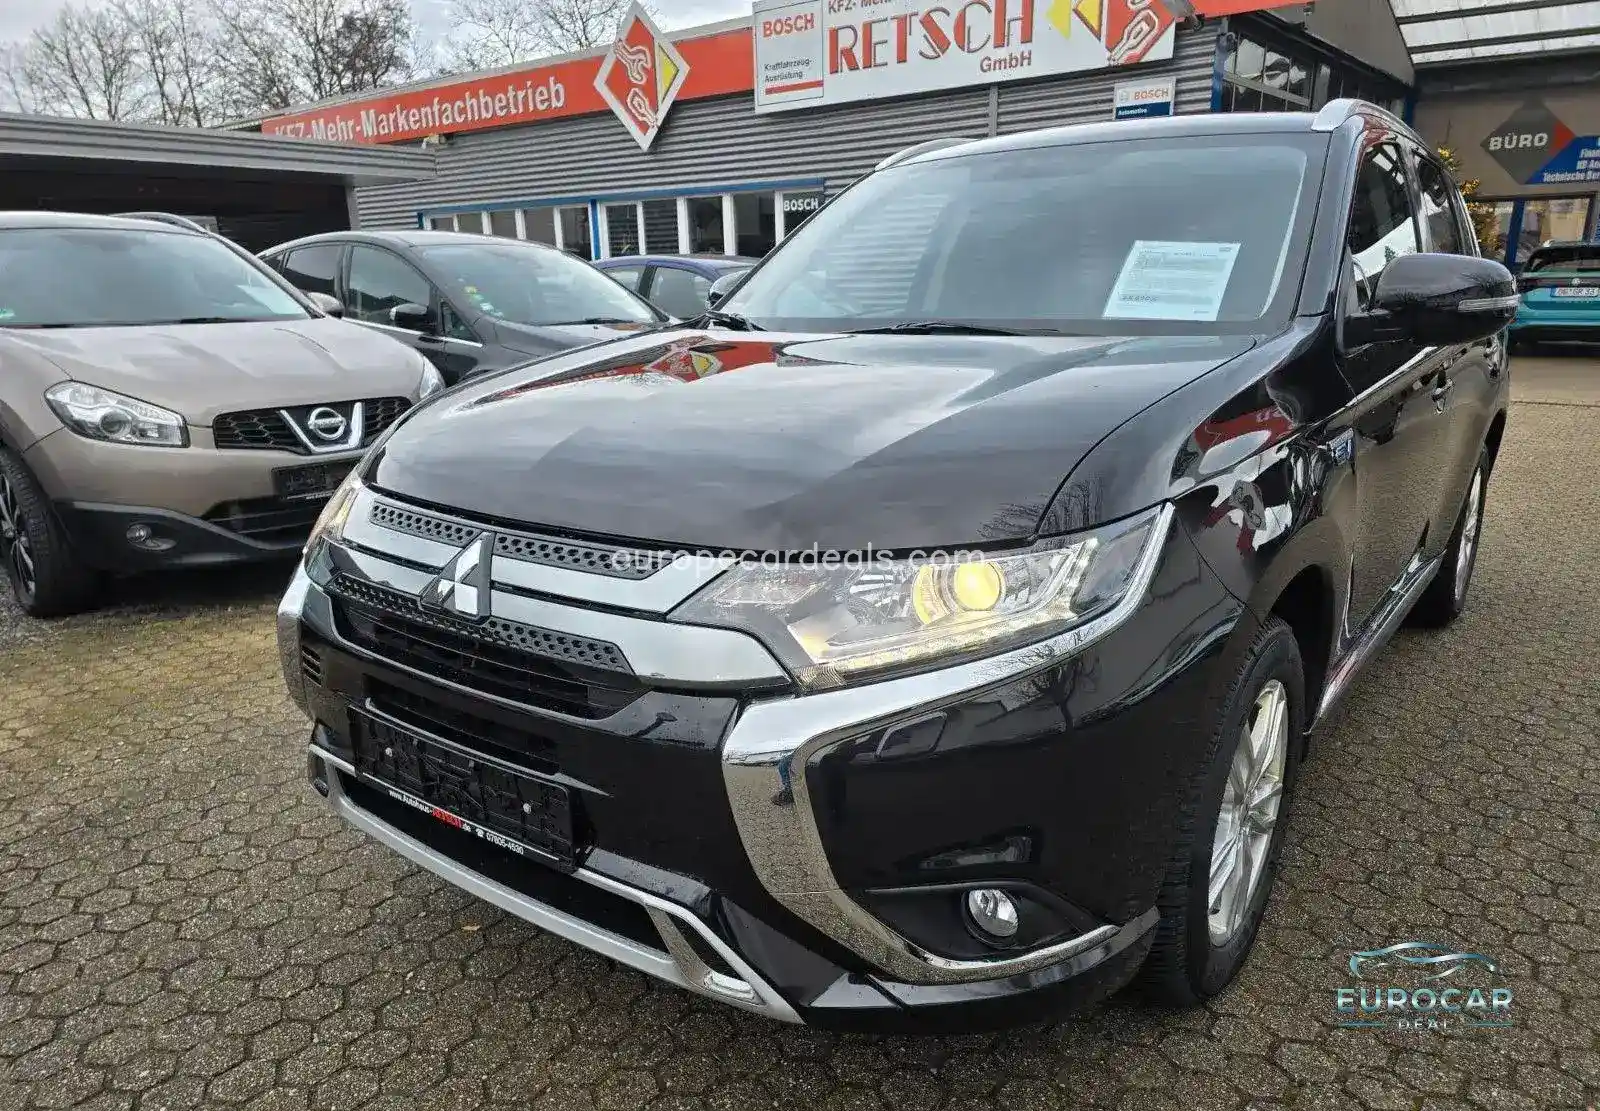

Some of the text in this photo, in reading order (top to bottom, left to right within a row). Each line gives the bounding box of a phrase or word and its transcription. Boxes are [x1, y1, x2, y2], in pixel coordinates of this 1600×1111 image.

[763, 13, 815, 38] BOSCH
[829, 0, 1033, 75] RETSCH
[979, 50, 1032, 73] GmbH
[1134, 88, 1170, 100] BOSCH
[1489, 131, 1548, 150] BÜRO
[783, 198, 819, 212] BOSCH
